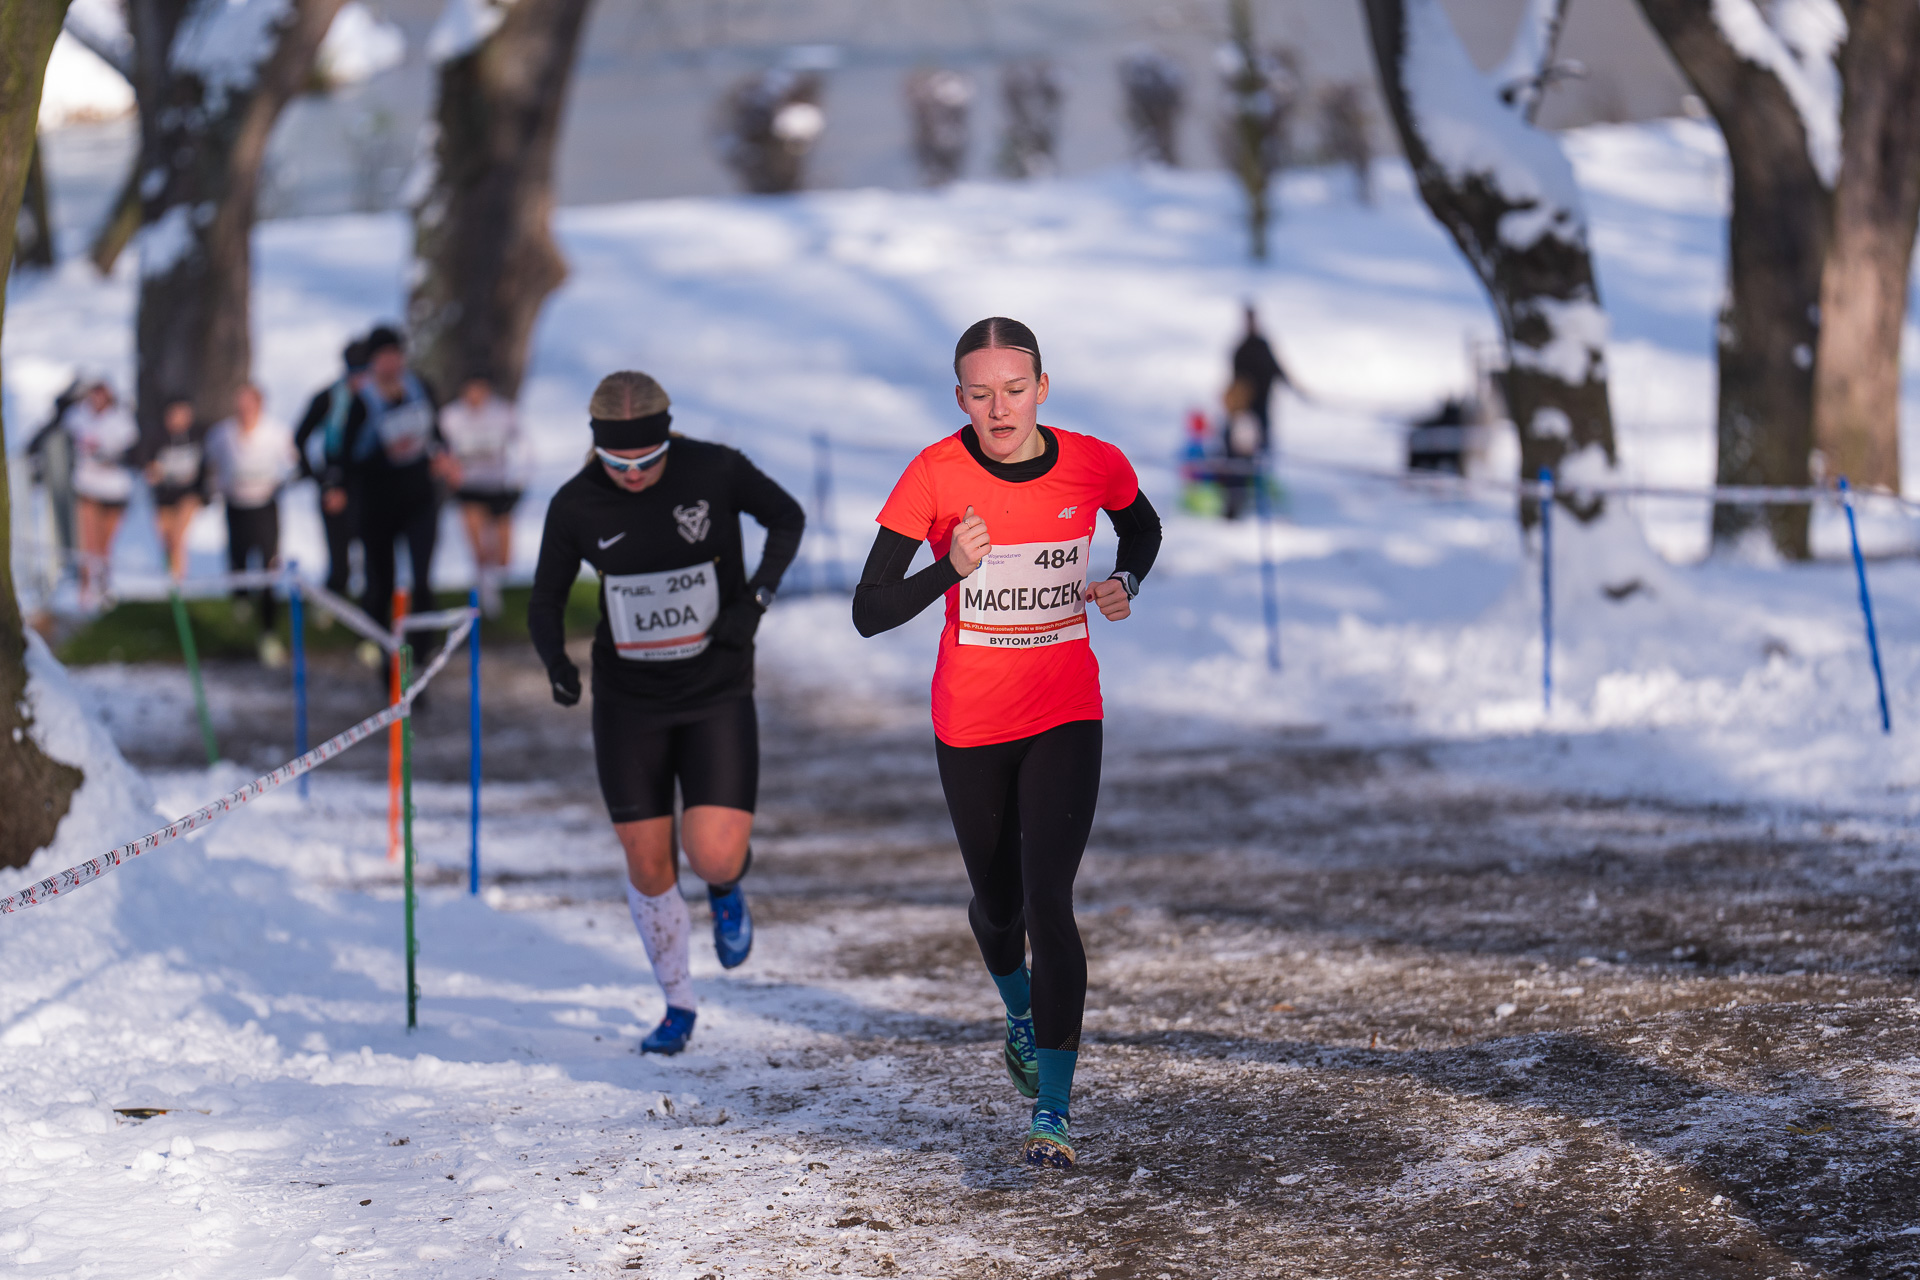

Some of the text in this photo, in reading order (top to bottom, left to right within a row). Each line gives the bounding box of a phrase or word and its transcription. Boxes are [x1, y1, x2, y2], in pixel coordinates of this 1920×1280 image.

[1057, 505, 1078, 519] 4F
[1034, 546, 1079, 570] 484
[667, 571, 706, 594] 204
[964, 579, 1083, 611] MACIEJCZEK
[635, 604, 699, 631] ŁADA
[1035, 623, 1055, 631] Biegach
[989, 633, 1059, 646] BYTOM 2024
